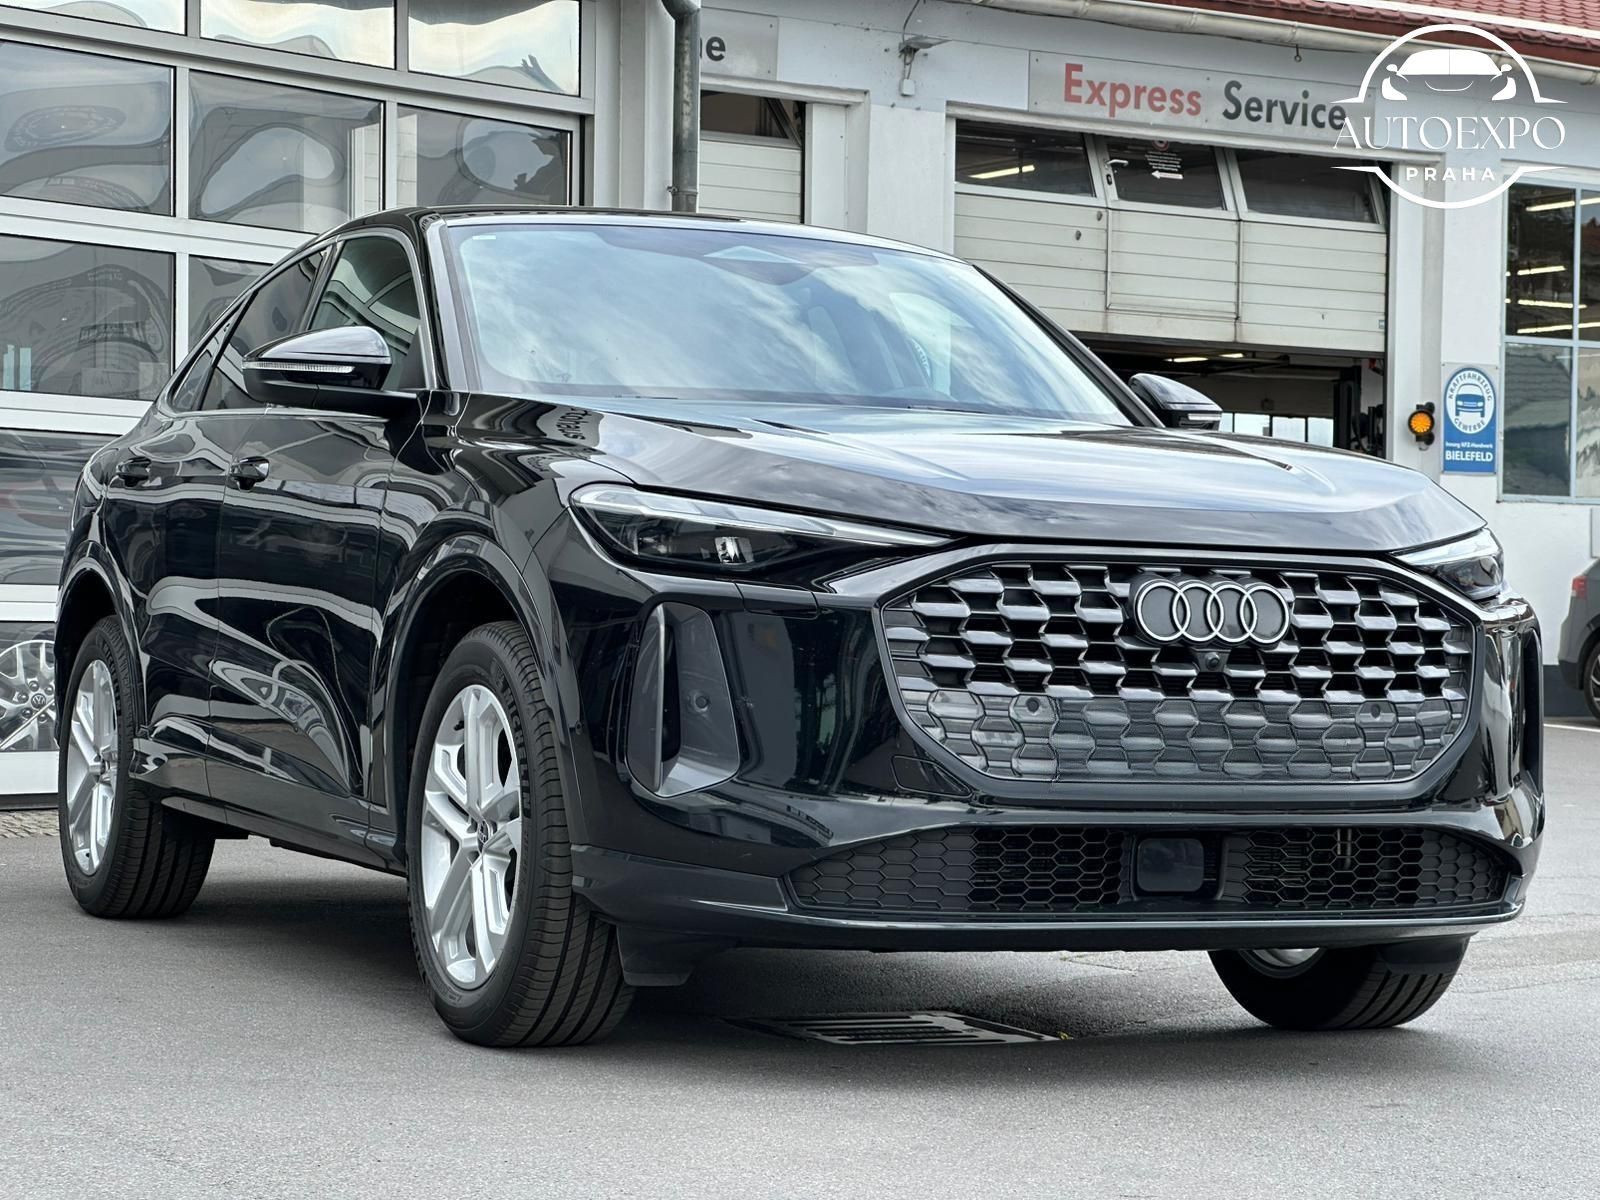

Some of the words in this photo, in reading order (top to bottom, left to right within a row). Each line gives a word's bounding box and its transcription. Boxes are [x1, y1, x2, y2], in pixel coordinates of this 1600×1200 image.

[1064, 63, 1202, 118] Express
[1222, 80, 1346, 130] Service
[1448, 372, 1493, 402] KRAFTFAHRZEUG
[1445, 450, 1493, 462] BIELEFELD
[503, 685, 531, 813] MICHELIN
